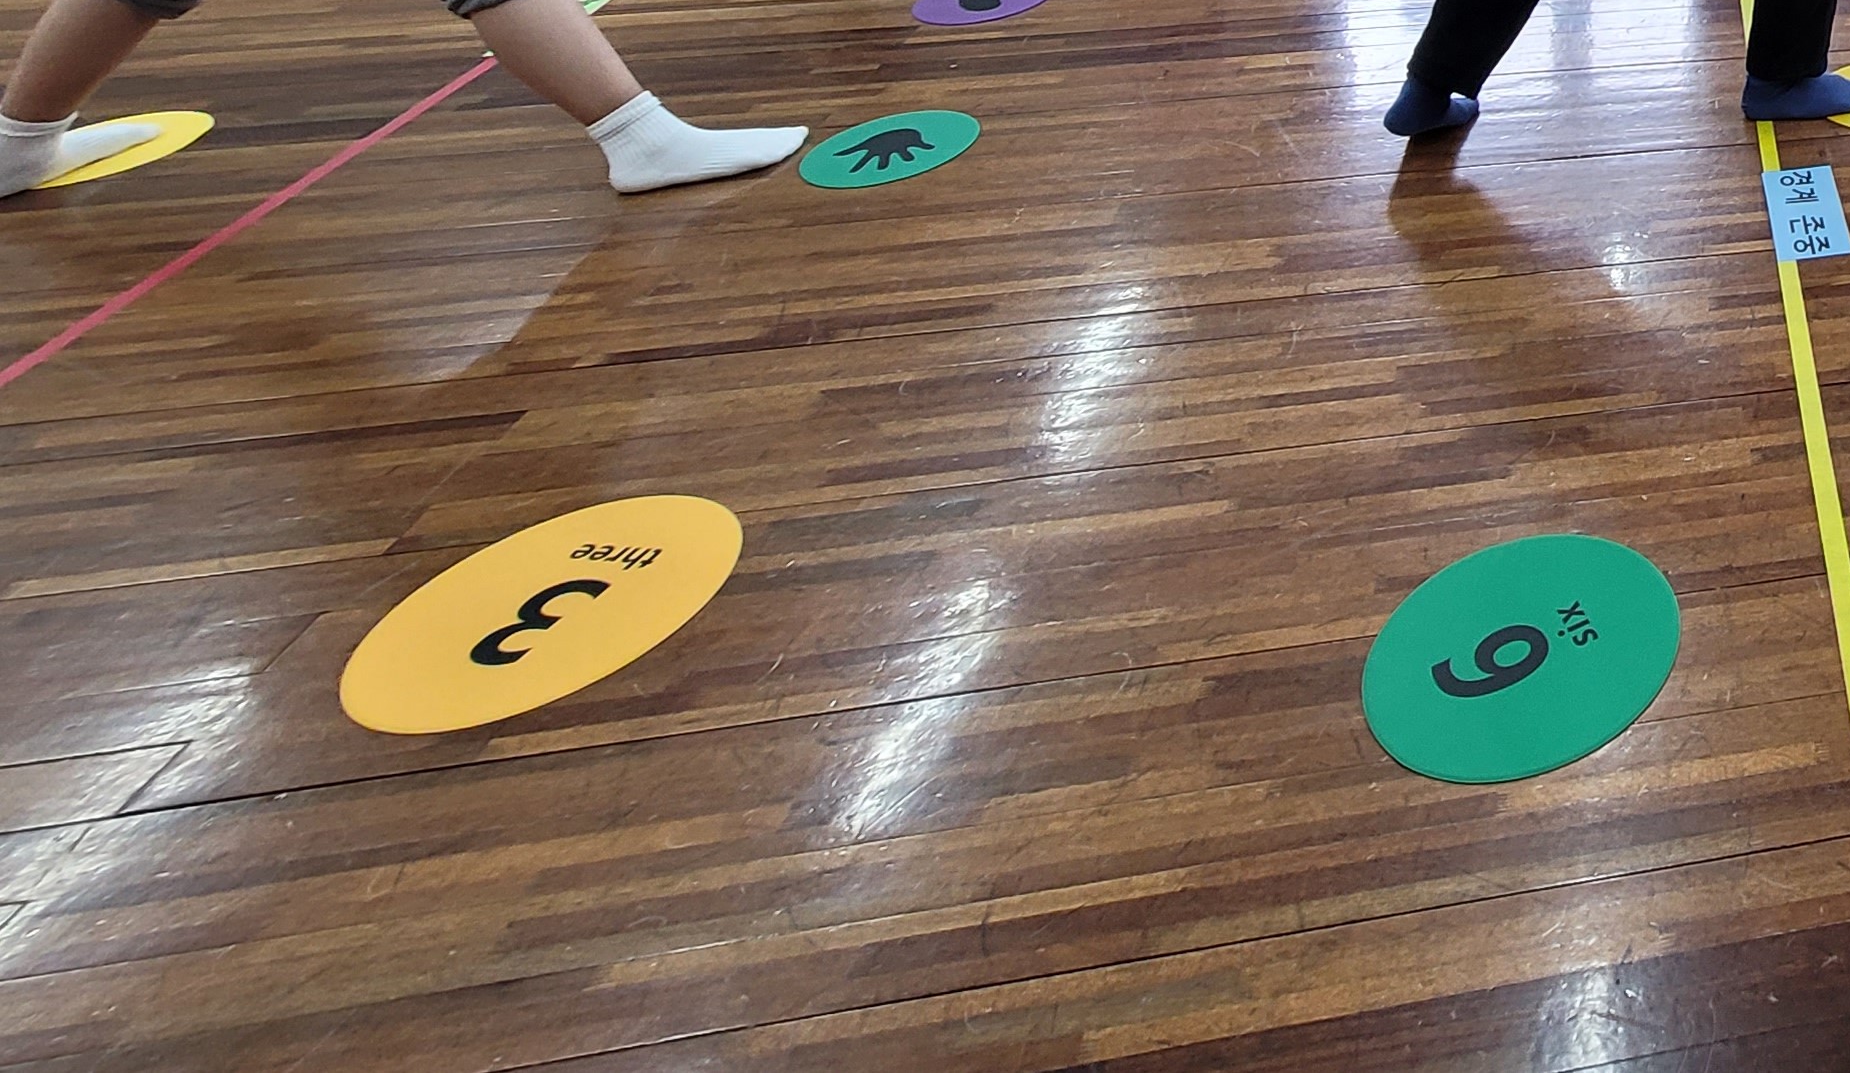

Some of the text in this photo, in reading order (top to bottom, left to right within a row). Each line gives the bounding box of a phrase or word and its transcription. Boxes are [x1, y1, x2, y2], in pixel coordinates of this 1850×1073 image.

[1780, 170, 1830, 255] 경계 존중
[570, 543, 662, 571] three
[469, 579, 612, 666] 3
[1556, 600, 1599, 647] six
